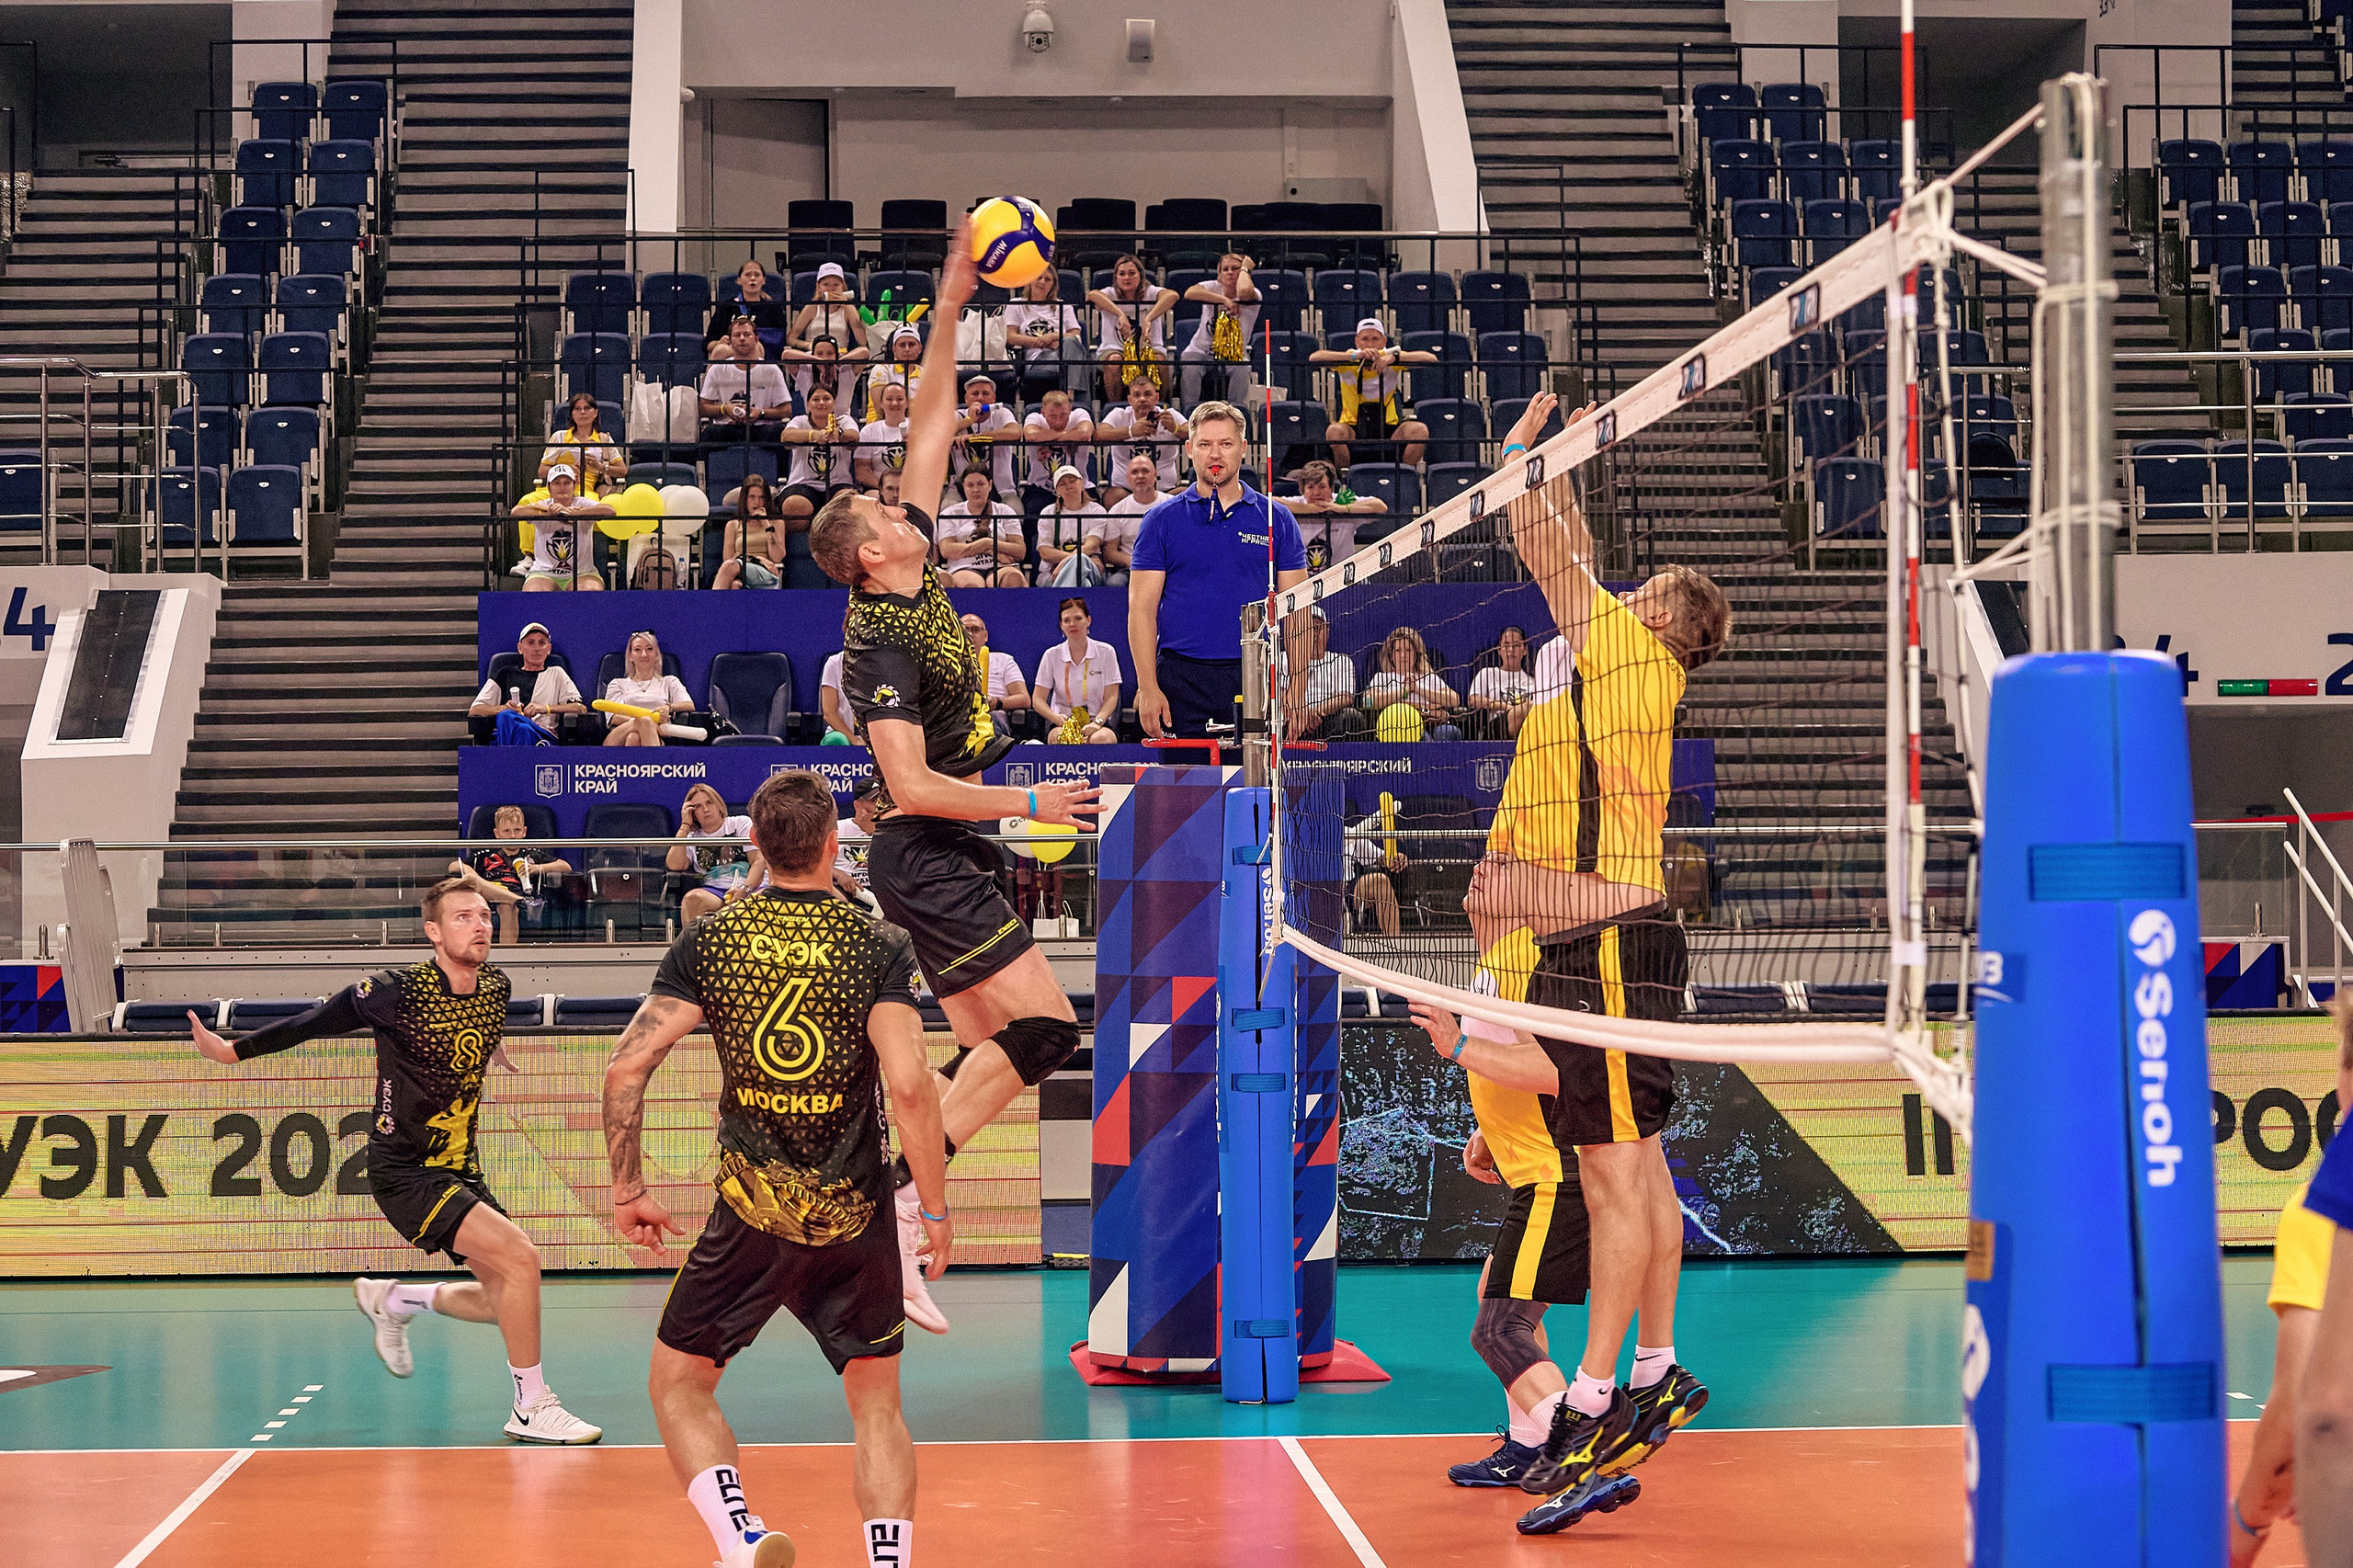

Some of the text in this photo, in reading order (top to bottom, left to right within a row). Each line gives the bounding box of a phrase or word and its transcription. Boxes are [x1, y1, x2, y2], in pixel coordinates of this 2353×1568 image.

[1242, 533, 1274, 542] ЧЕСТНА
[0, 586, 56, 652] 4
[2325, 632, 2353, 696] 2
[574, 762, 706, 778] КРАСНОЯРСКИЙ
[574, 778, 618, 793] КРАЙ
[810, 763, 873, 777] КРАСНО
[750, 934, 833, 967] СУЭК
[753, 977, 825, 1082] 6
[382, 1078, 392, 1113] СУЭК
[2133, 971, 2183, 1187] Senoh
[736, 1087, 844, 1115] МОСКВА
[0, 1112, 374, 1199] УЭК 202
[870, 1523, 900, 1568] ELI
